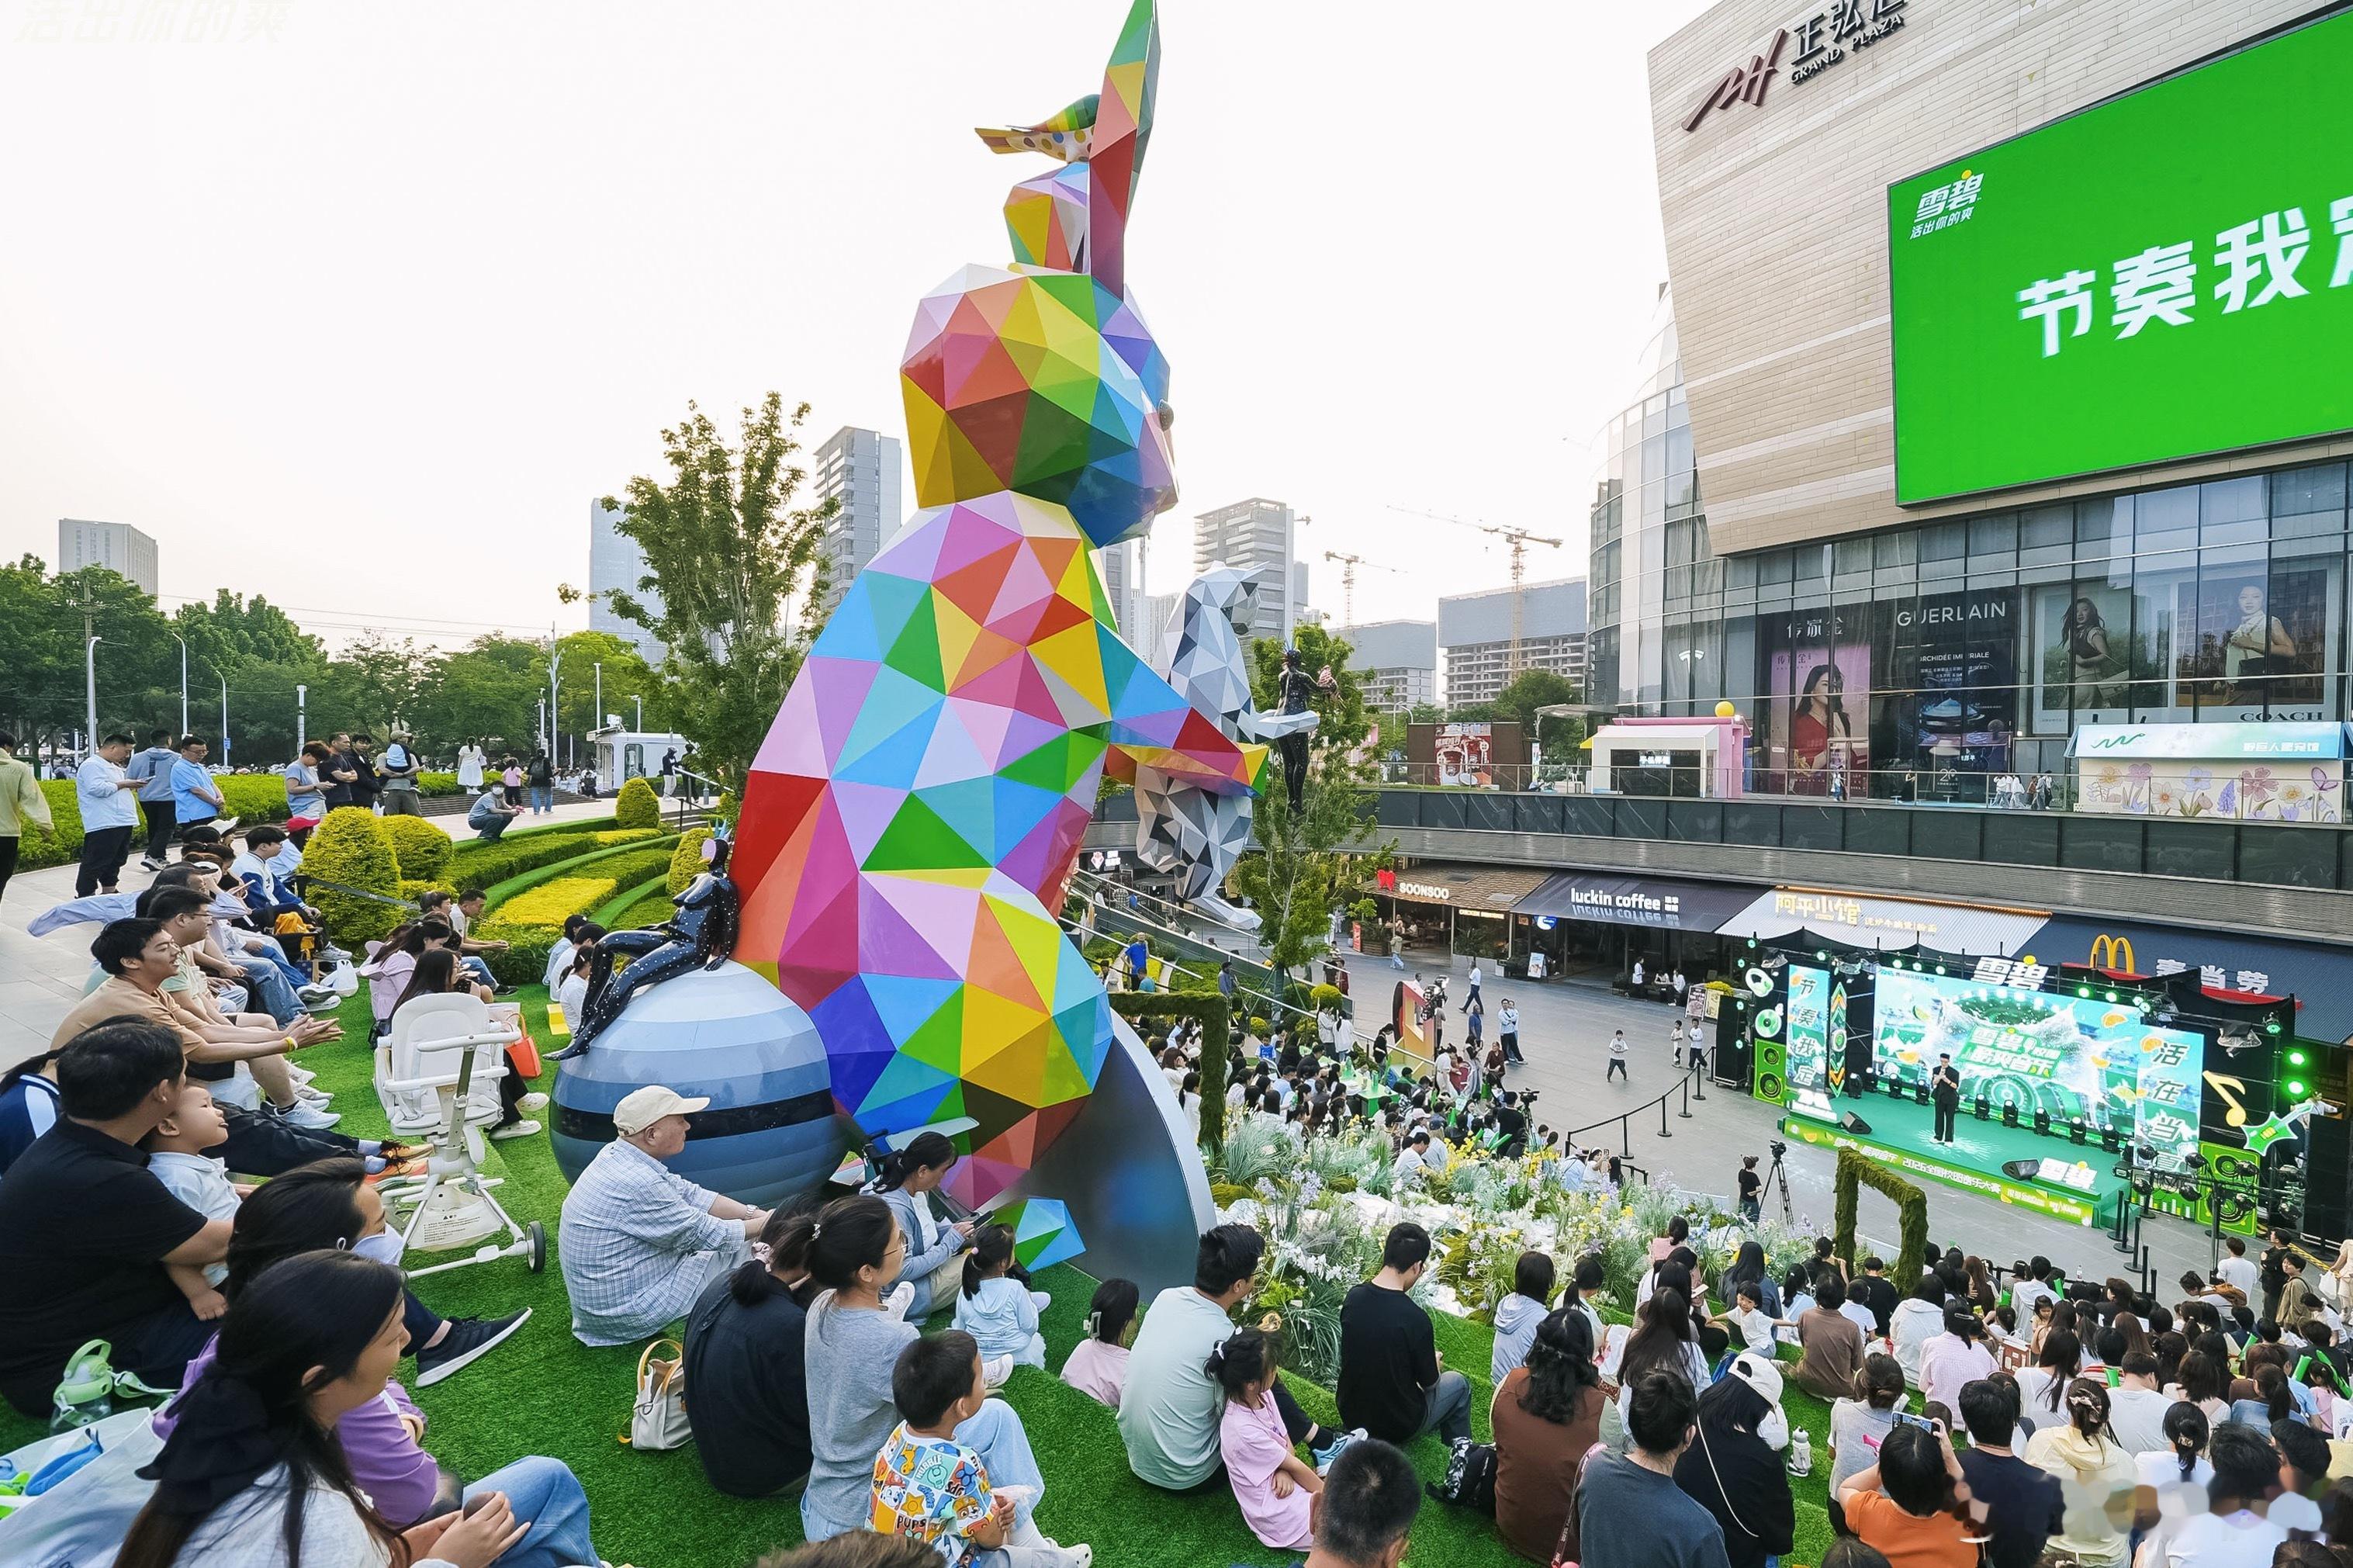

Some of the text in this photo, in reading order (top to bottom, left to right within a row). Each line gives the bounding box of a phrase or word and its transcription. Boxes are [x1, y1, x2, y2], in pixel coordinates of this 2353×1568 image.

[1791, 13, 1904, 85] GRAND PLAZA
[1914, 172, 1984, 223] 雪碧
[1909, 206, 1974, 240] 活出你的爽
[2016, 194, 2353, 359] 节奏我
[1897, 601, 2006, 627] GUERLAIN
[2240, 711, 2323, 722] COACH
[1399, 882, 1449, 901] SOONSOO
[1570, 887, 1613, 906] luckin
[1615, 893, 1661, 911] coffee
[1774, 893, 1862, 926] 阿平小馆
[1971, 956, 2050, 992] 雪碧
[1794, 978, 1818, 1086] 节奏我定
[1968, 1026, 2024, 1052] 雪碧
[2036, 1157, 2098, 1190] 雪碧
[897, 1515, 927, 1529] PUPS
